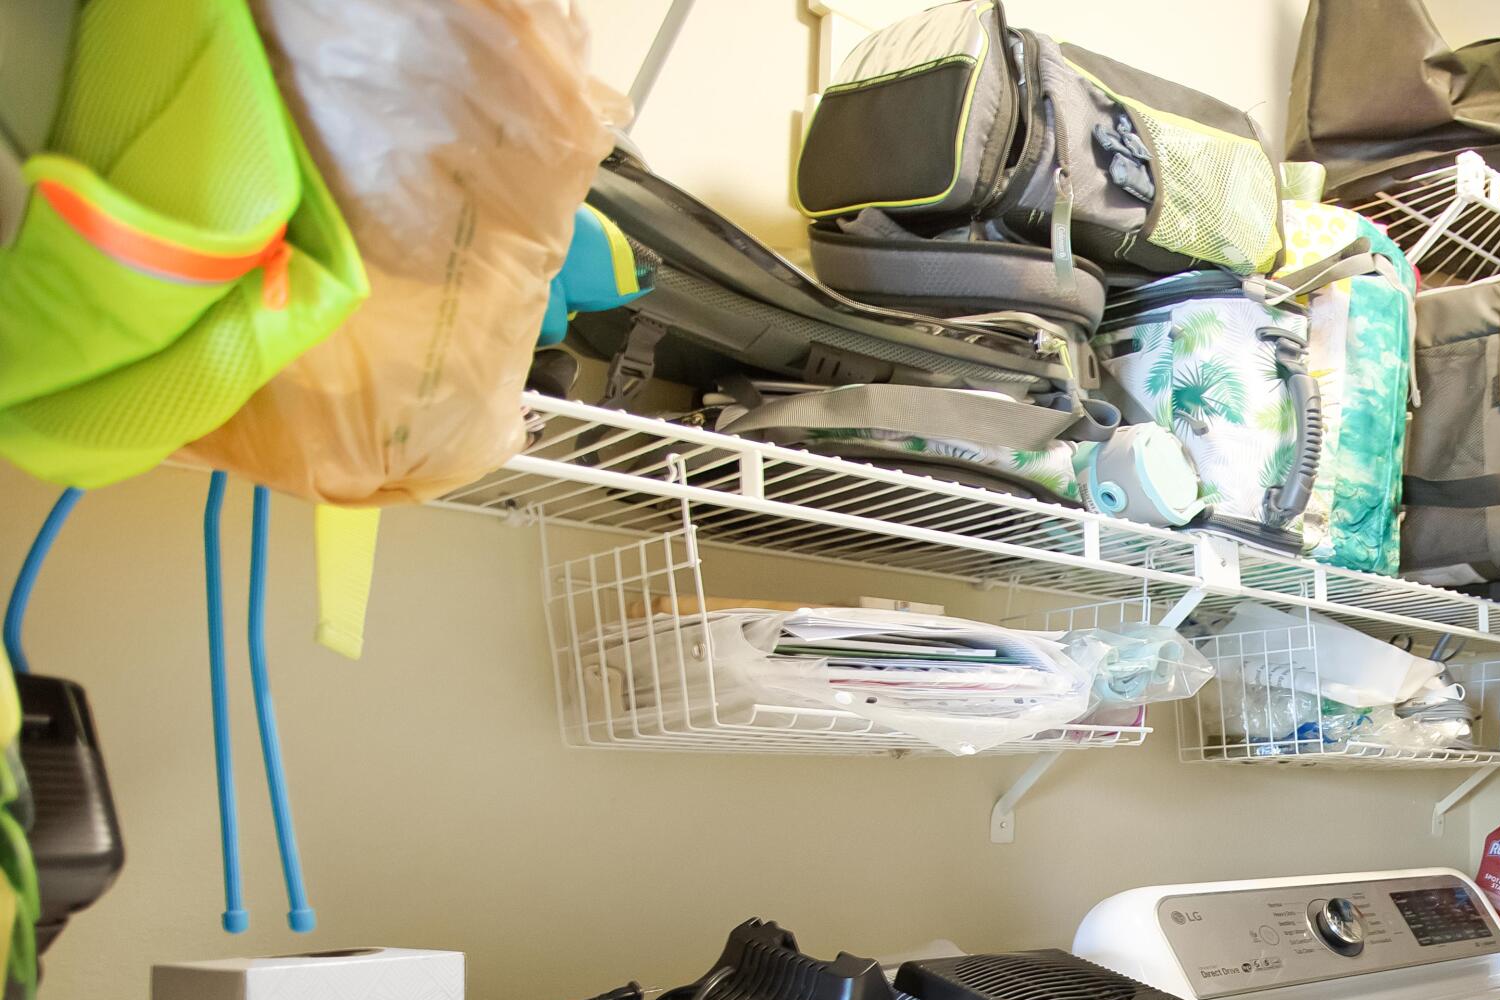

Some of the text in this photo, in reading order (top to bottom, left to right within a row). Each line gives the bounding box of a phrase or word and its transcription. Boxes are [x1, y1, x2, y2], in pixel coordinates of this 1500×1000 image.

[1186, 911, 1203, 923] LG
[1200, 968, 1223, 979] Direct
[1222, 967, 1241, 976] Drive
